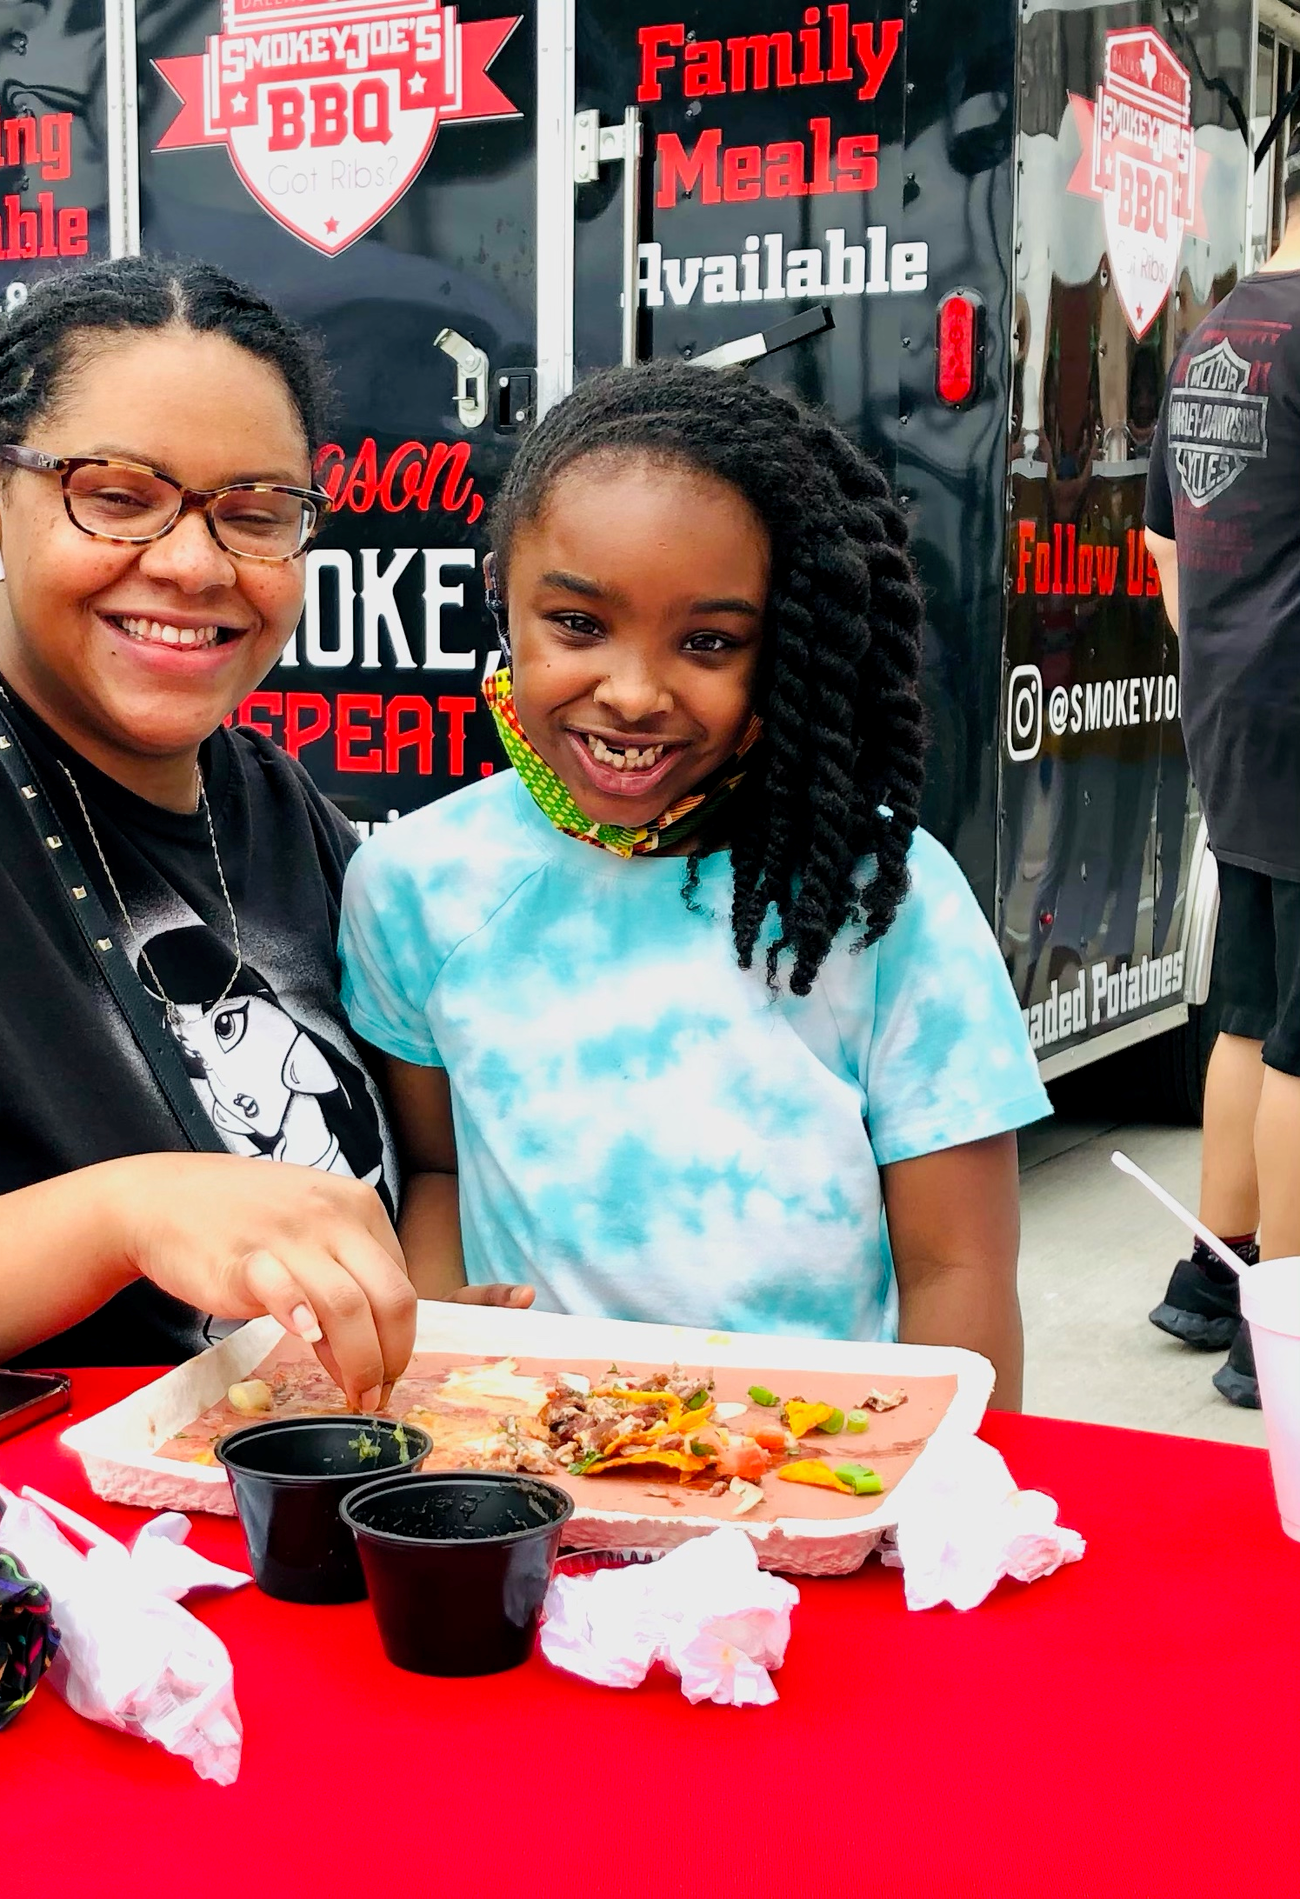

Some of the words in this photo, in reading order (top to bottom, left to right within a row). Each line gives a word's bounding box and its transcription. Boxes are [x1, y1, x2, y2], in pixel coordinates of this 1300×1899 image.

[637, 3, 904, 102] Family
[267, 77, 393, 152] BBQ
[267, 164, 318, 195] Got
[331, 155, 399, 190] Ribs?
[656, 117, 879, 209] Meals
[1117, 160, 1169, 243] BBQ
[621, 226, 929, 308] Available
[1190, 353, 1239, 391] MOTOR
[1182, 449, 1230, 497] CYCLES
[1017, 519, 1119, 596] Follow
[1127, 528, 1161, 597] Us
[279, 547, 503, 677] OKE,
[222, 691, 494, 777] EPEAT.
[1091, 950, 1184, 1026] Potatoes
